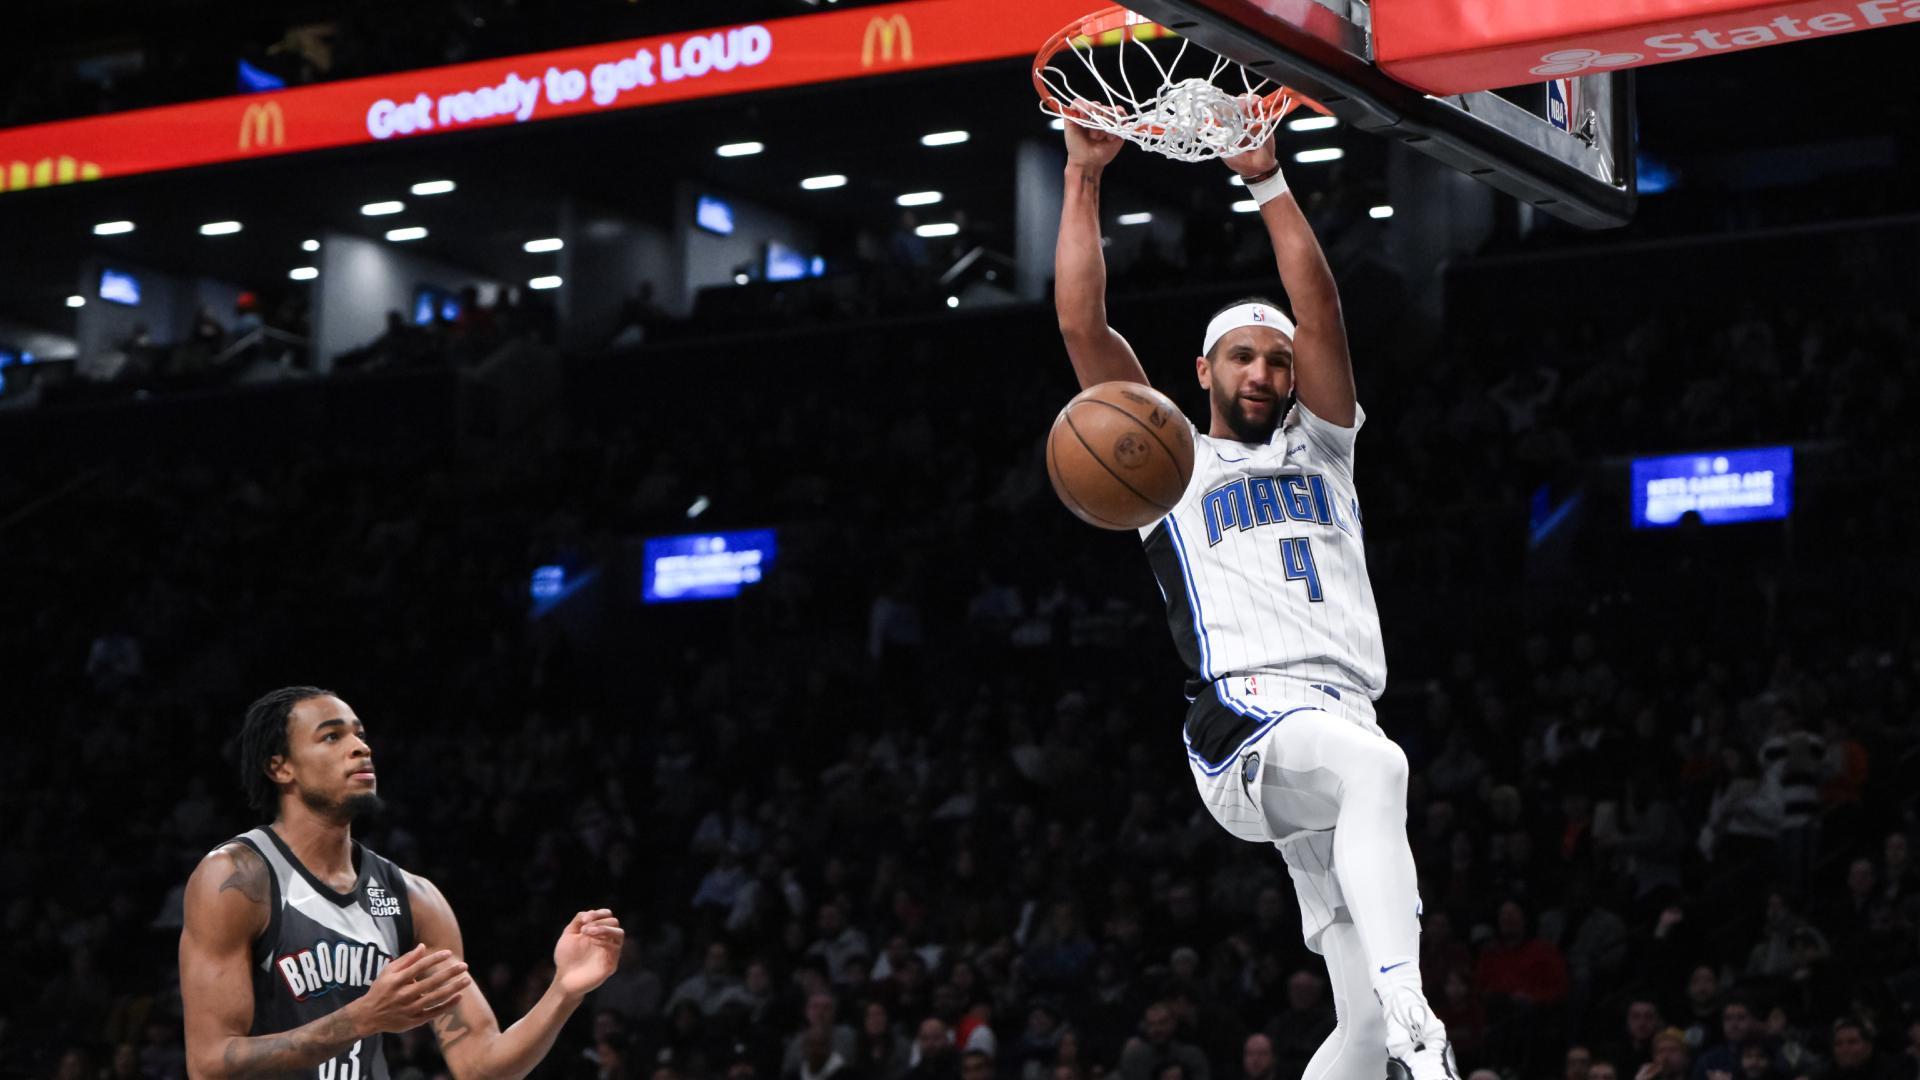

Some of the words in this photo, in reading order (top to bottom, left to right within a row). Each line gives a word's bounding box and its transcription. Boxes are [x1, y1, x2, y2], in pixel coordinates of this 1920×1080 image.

[1643, 12, 1856, 58] State
[366, 92, 433, 140] Get
[438, 72, 540, 122] ready
[545, 66, 587, 104] to
[590, 48, 656, 105] get
[660, 24, 772, 82] LOUD
[1551, 97, 1565, 124] NBA
[1279, 537, 1324, 602] 4
[367, 887, 385, 898] GET
[369, 896, 399, 907] YOUR
[370, 906, 401, 916] GUIDE
